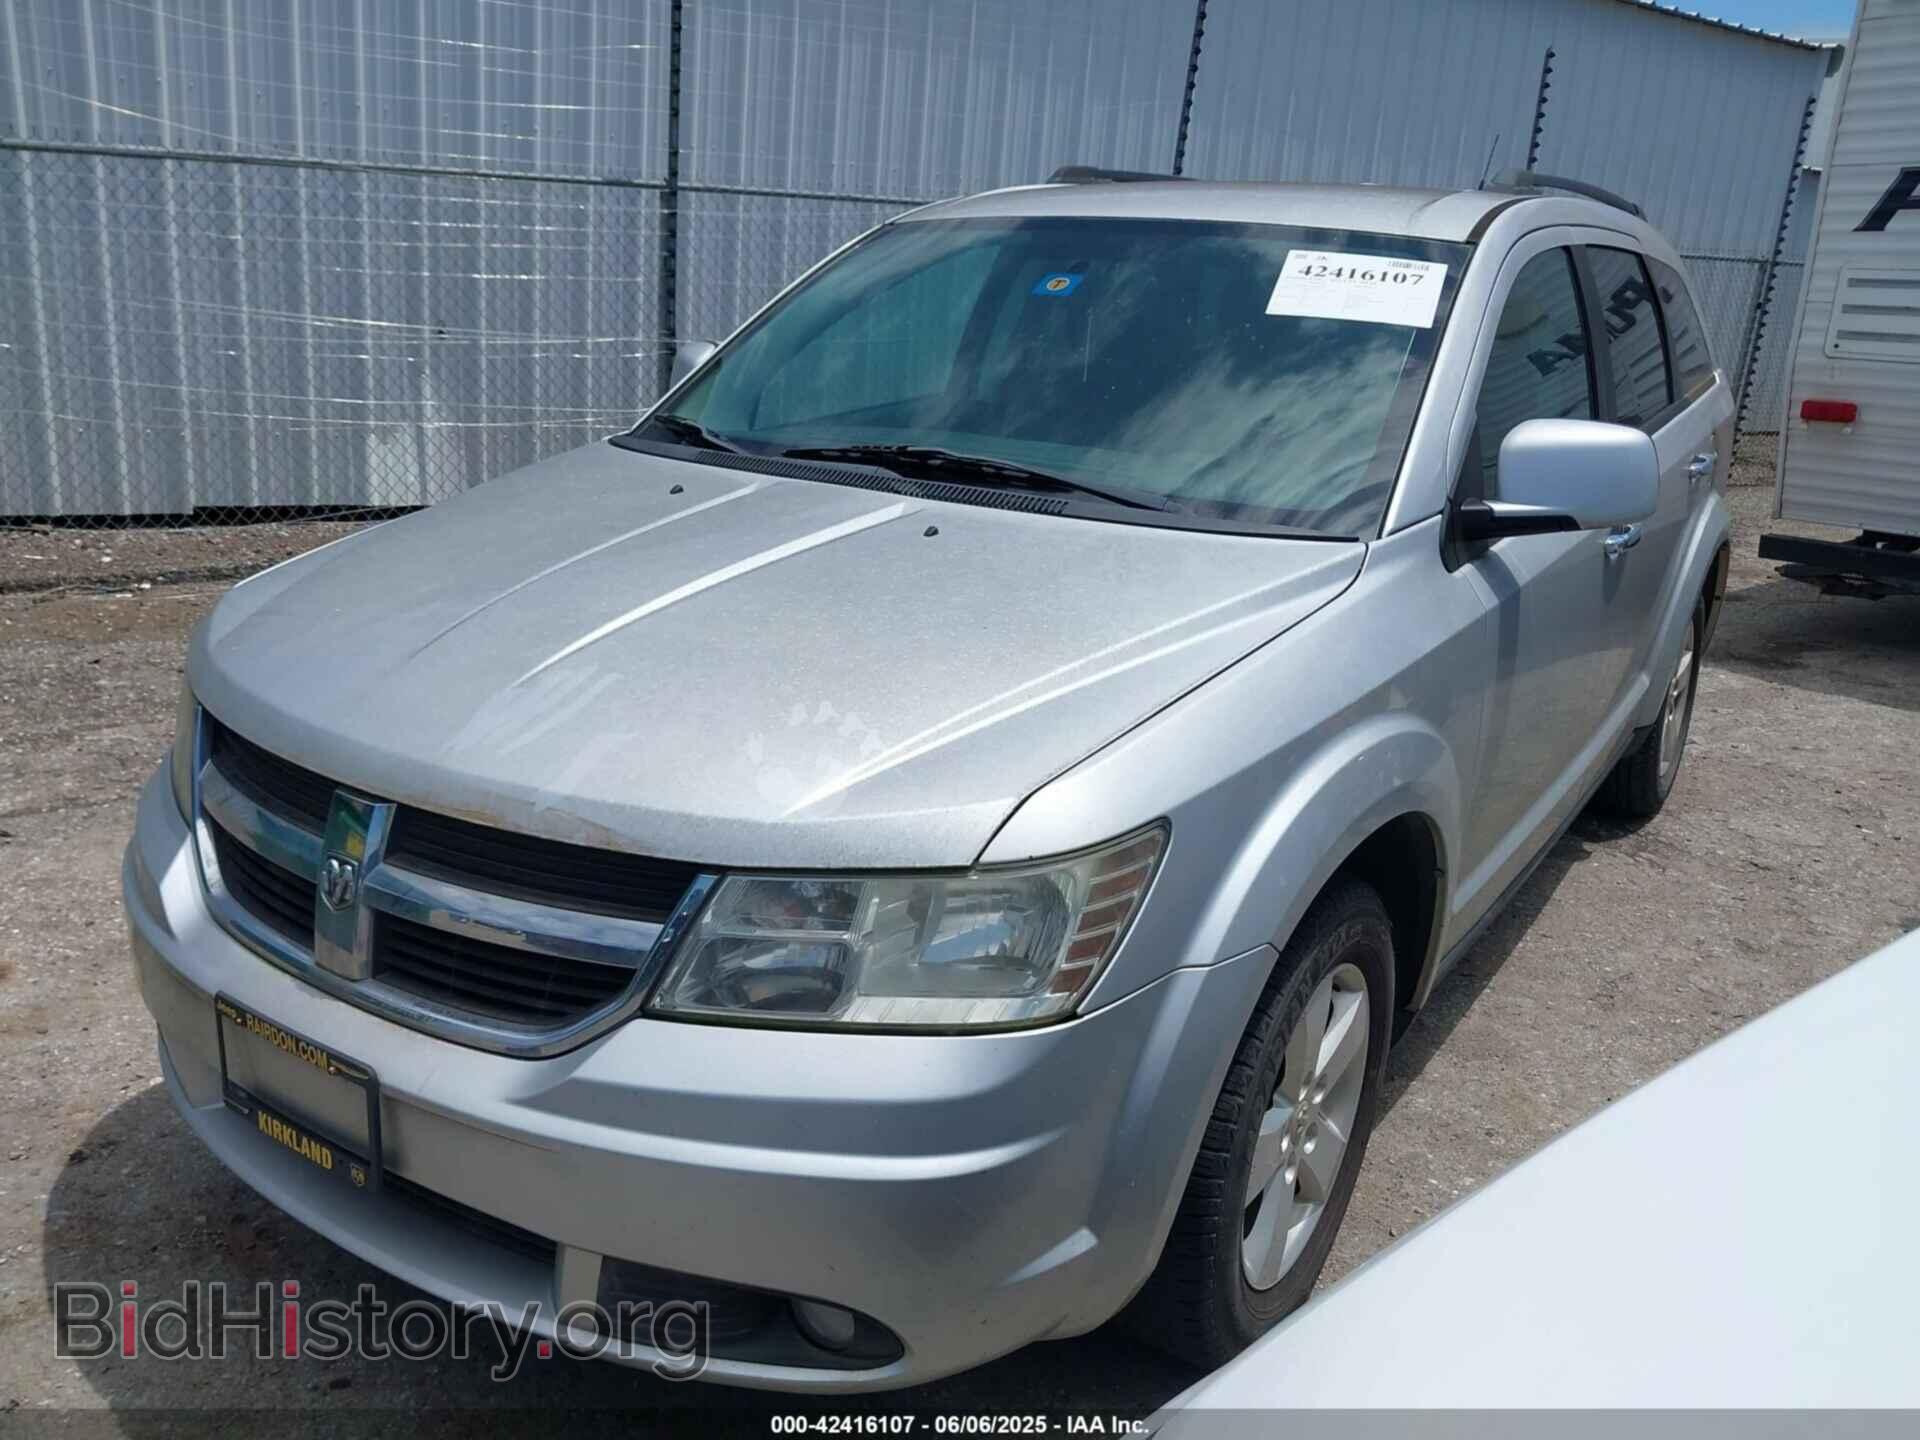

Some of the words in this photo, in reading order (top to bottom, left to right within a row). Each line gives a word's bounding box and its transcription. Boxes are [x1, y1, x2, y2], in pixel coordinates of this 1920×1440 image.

[1297, 264, 1425, 286] 42416107
[246, 1013, 328, 1069] RAIRDON.COM
[258, 1110, 333, 1170] KIRKLAND
